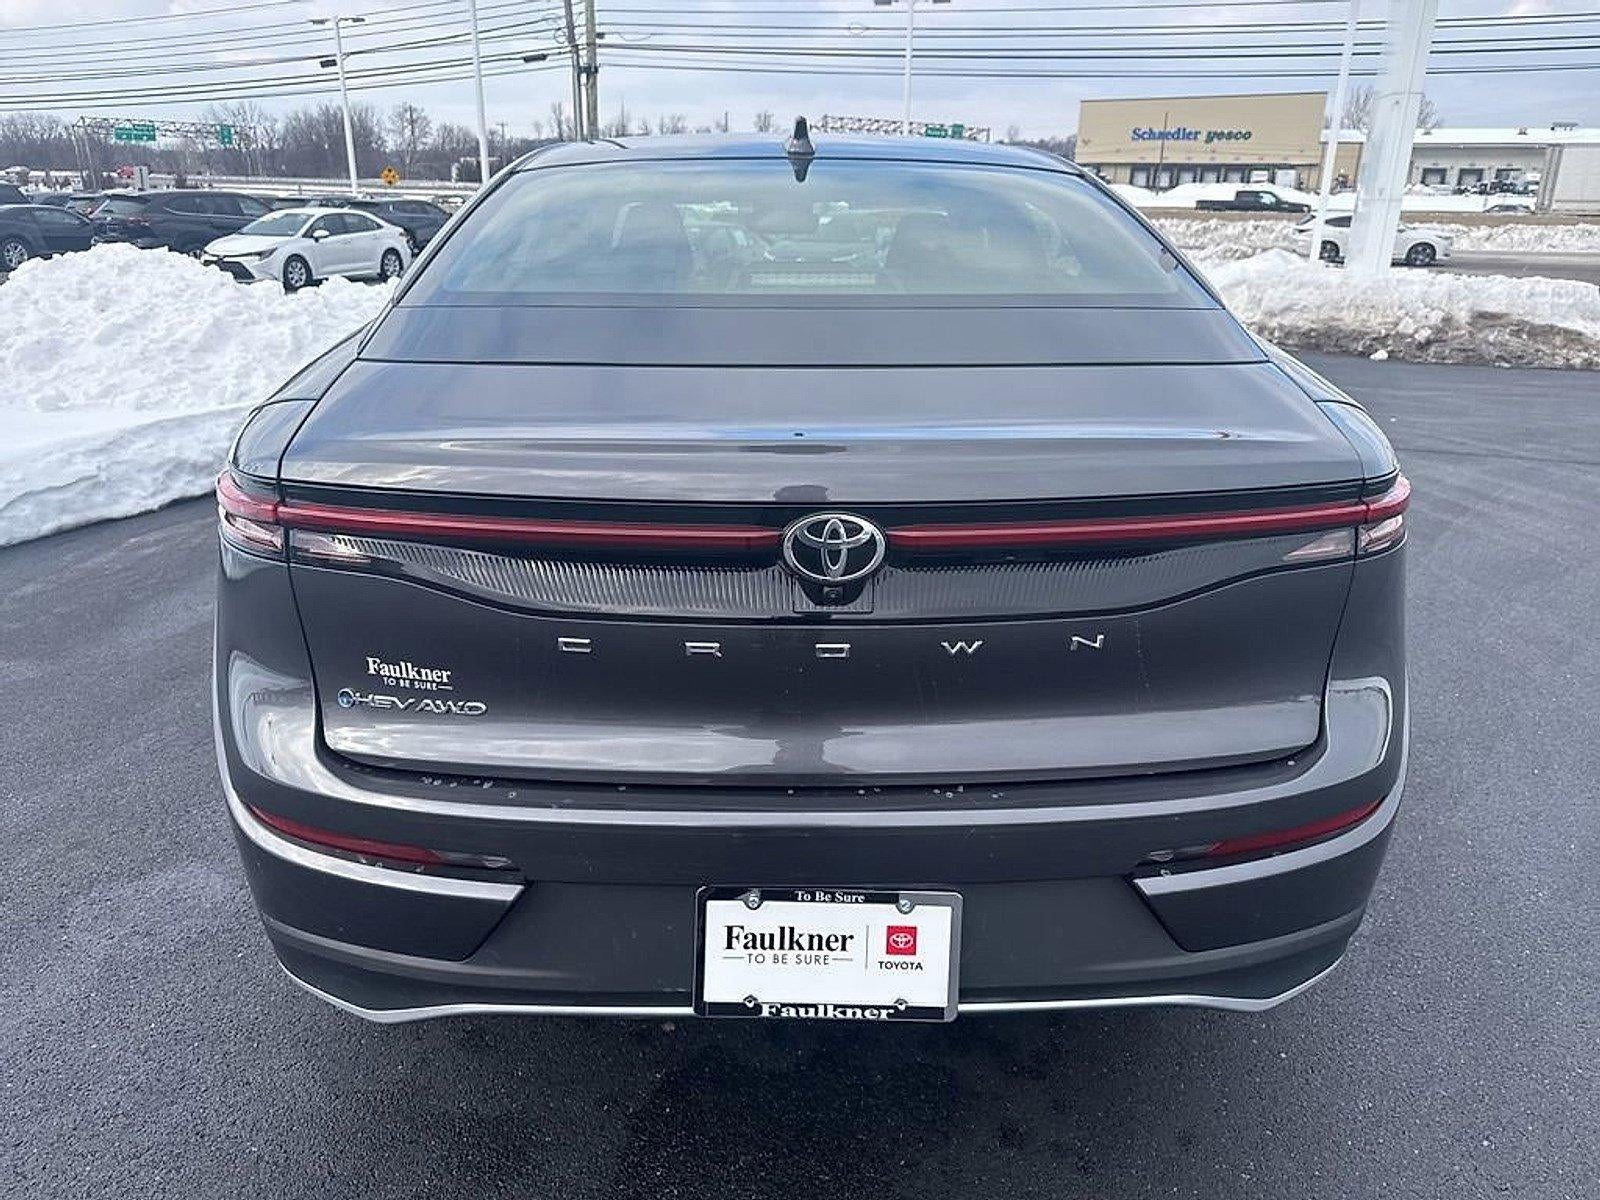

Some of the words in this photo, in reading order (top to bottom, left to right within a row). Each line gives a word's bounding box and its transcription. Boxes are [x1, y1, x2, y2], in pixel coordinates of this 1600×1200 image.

[557, 634, 1105, 658] CROWN
[366, 656, 452, 683] Faulkner
[383, 677, 396, 686] TO
[400, 679, 411, 688] BE
[414, 681, 438, 691] SURE
[355, 691, 415, 709] HEV
[415, 699, 488, 716] AWD
[795, 890, 811, 902] To
[815, 891, 832, 902] Be
[834, 892, 865, 903] Sure
[724, 925, 855, 952] Faulkner
[747, 953, 766, 965] TO
[773, 954, 788, 965] BE
[796, 954, 830, 966] SURE
[878, 961, 923, 971] TOYOTA
[760, 1003, 895, 1020] Faulkner
